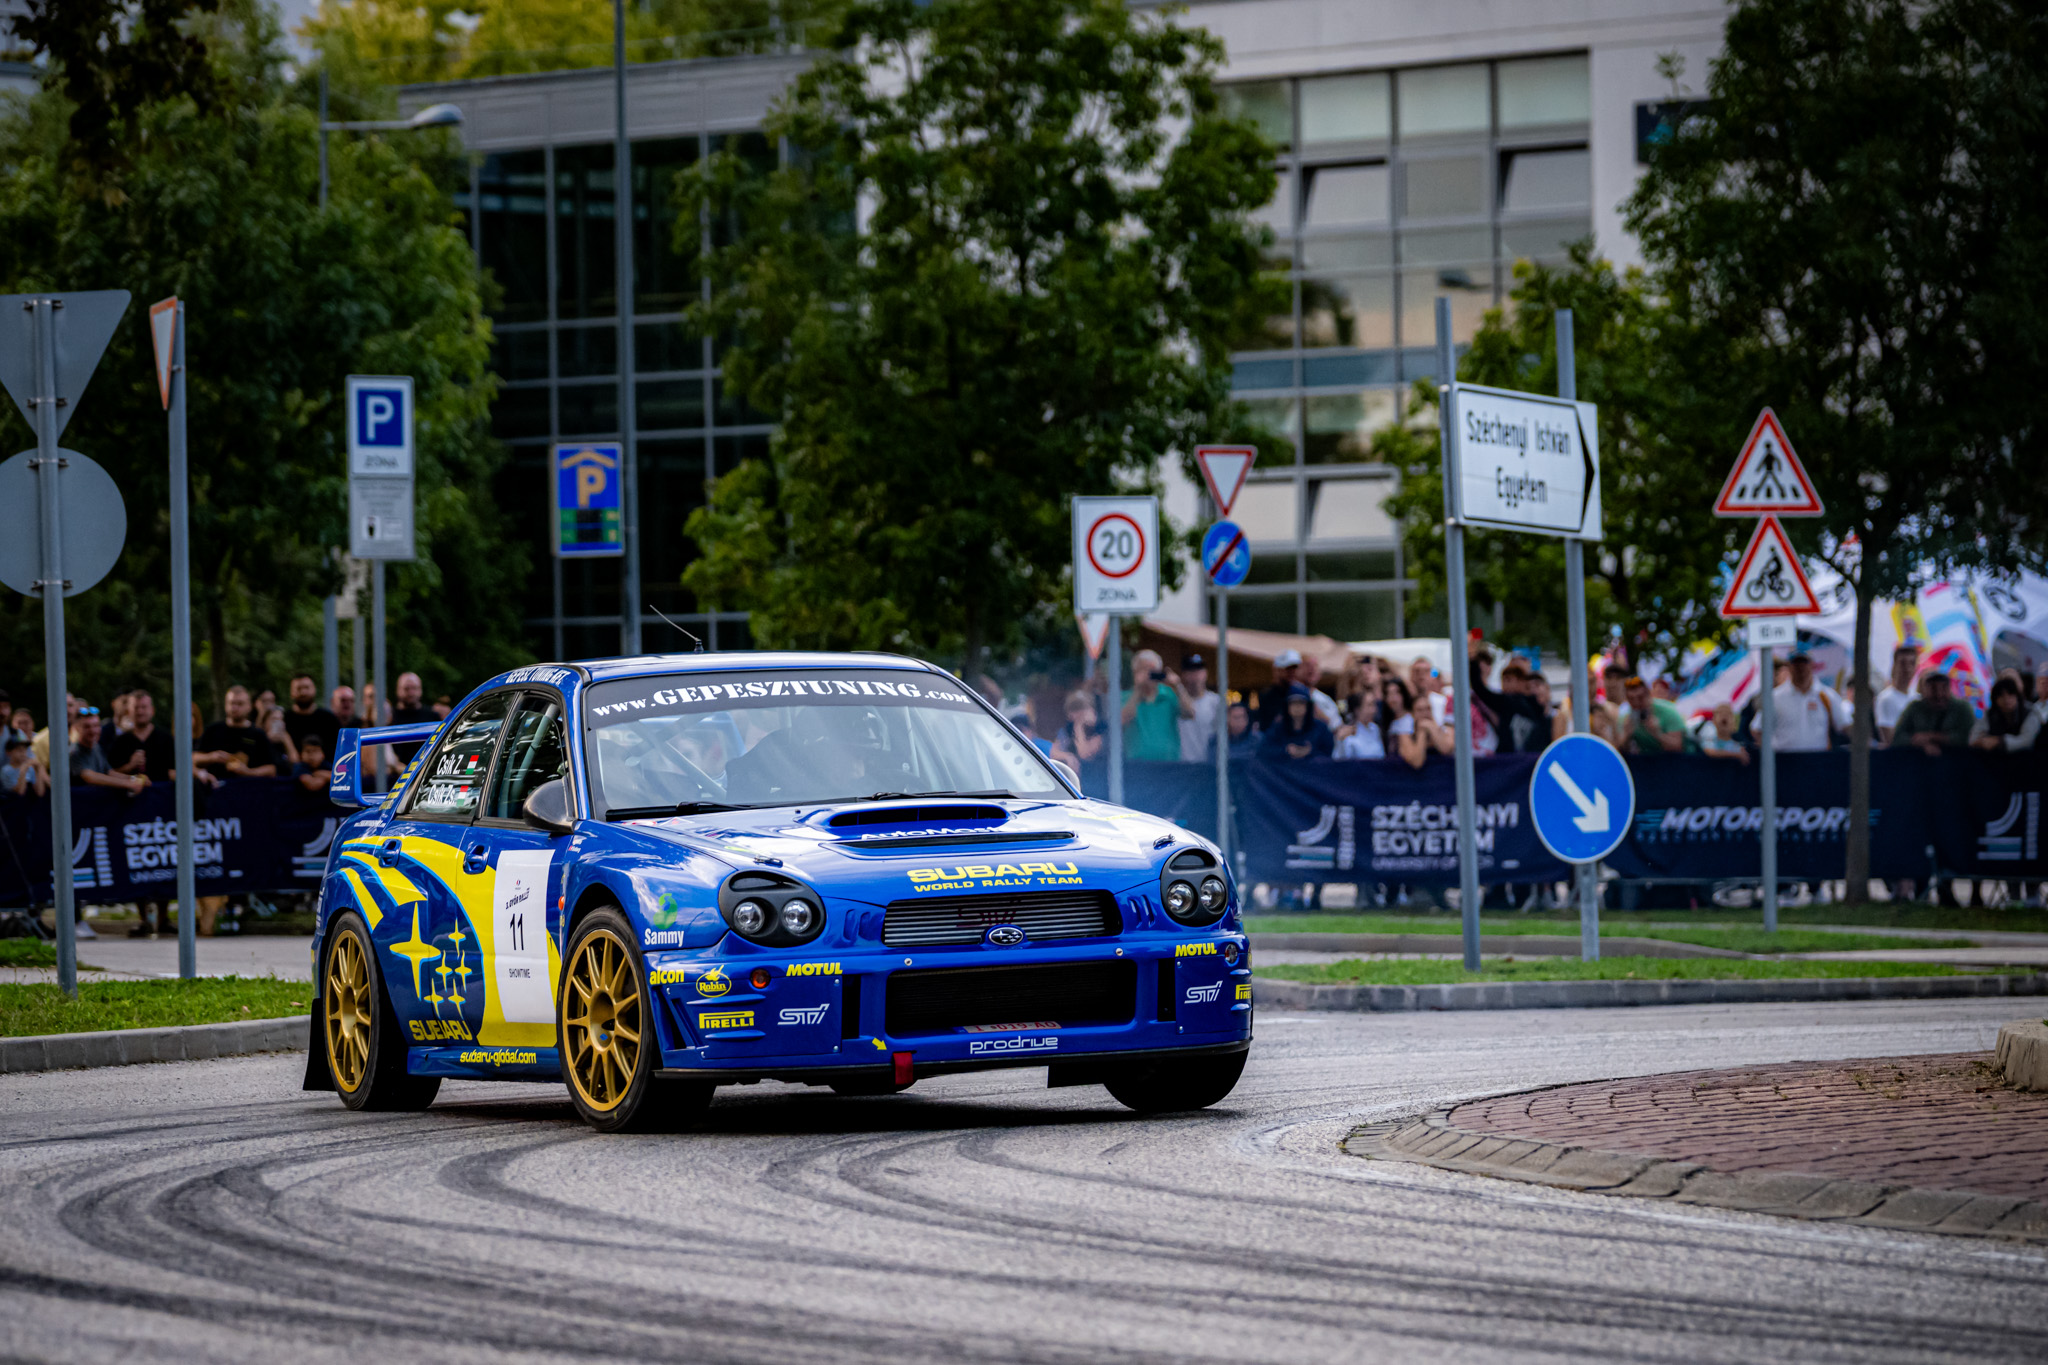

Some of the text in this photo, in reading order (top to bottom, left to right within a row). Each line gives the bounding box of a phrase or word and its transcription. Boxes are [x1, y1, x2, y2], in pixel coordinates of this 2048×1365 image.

[365, 395, 395, 441] P
[1466, 409, 1572, 458] Széchenyi István
[577, 466, 607, 508] P
[1496, 465, 1548, 508] Egyetem
[1101, 530, 1134, 560] 20
[1370, 800, 1519, 830] SZÉCHNYI
[123, 816, 241, 846] SZÉCENYI
[1371, 829, 1495, 855] EGYETM
[906, 861, 1079, 883] SUBARU
[914, 876, 1083, 893] WORLD RALLY TEAM
[509, 912, 525, 951] 11
[644, 928, 684, 947] Sammy
[1175, 943, 1217, 957] MOTUL
[508, 968, 531, 979] SHOWTIME
[649, 966, 685, 985] alcon
[786, 962, 843, 977] MOTUL
[699, 981, 728, 993] Robin
[699, 1010, 755, 1029] PIRELLI
[409, 1020, 473, 1041] SUBARU
[970, 1036, 1058, 1054] prodrive
[460, 1049, 537, 1067] subaru-global.com
